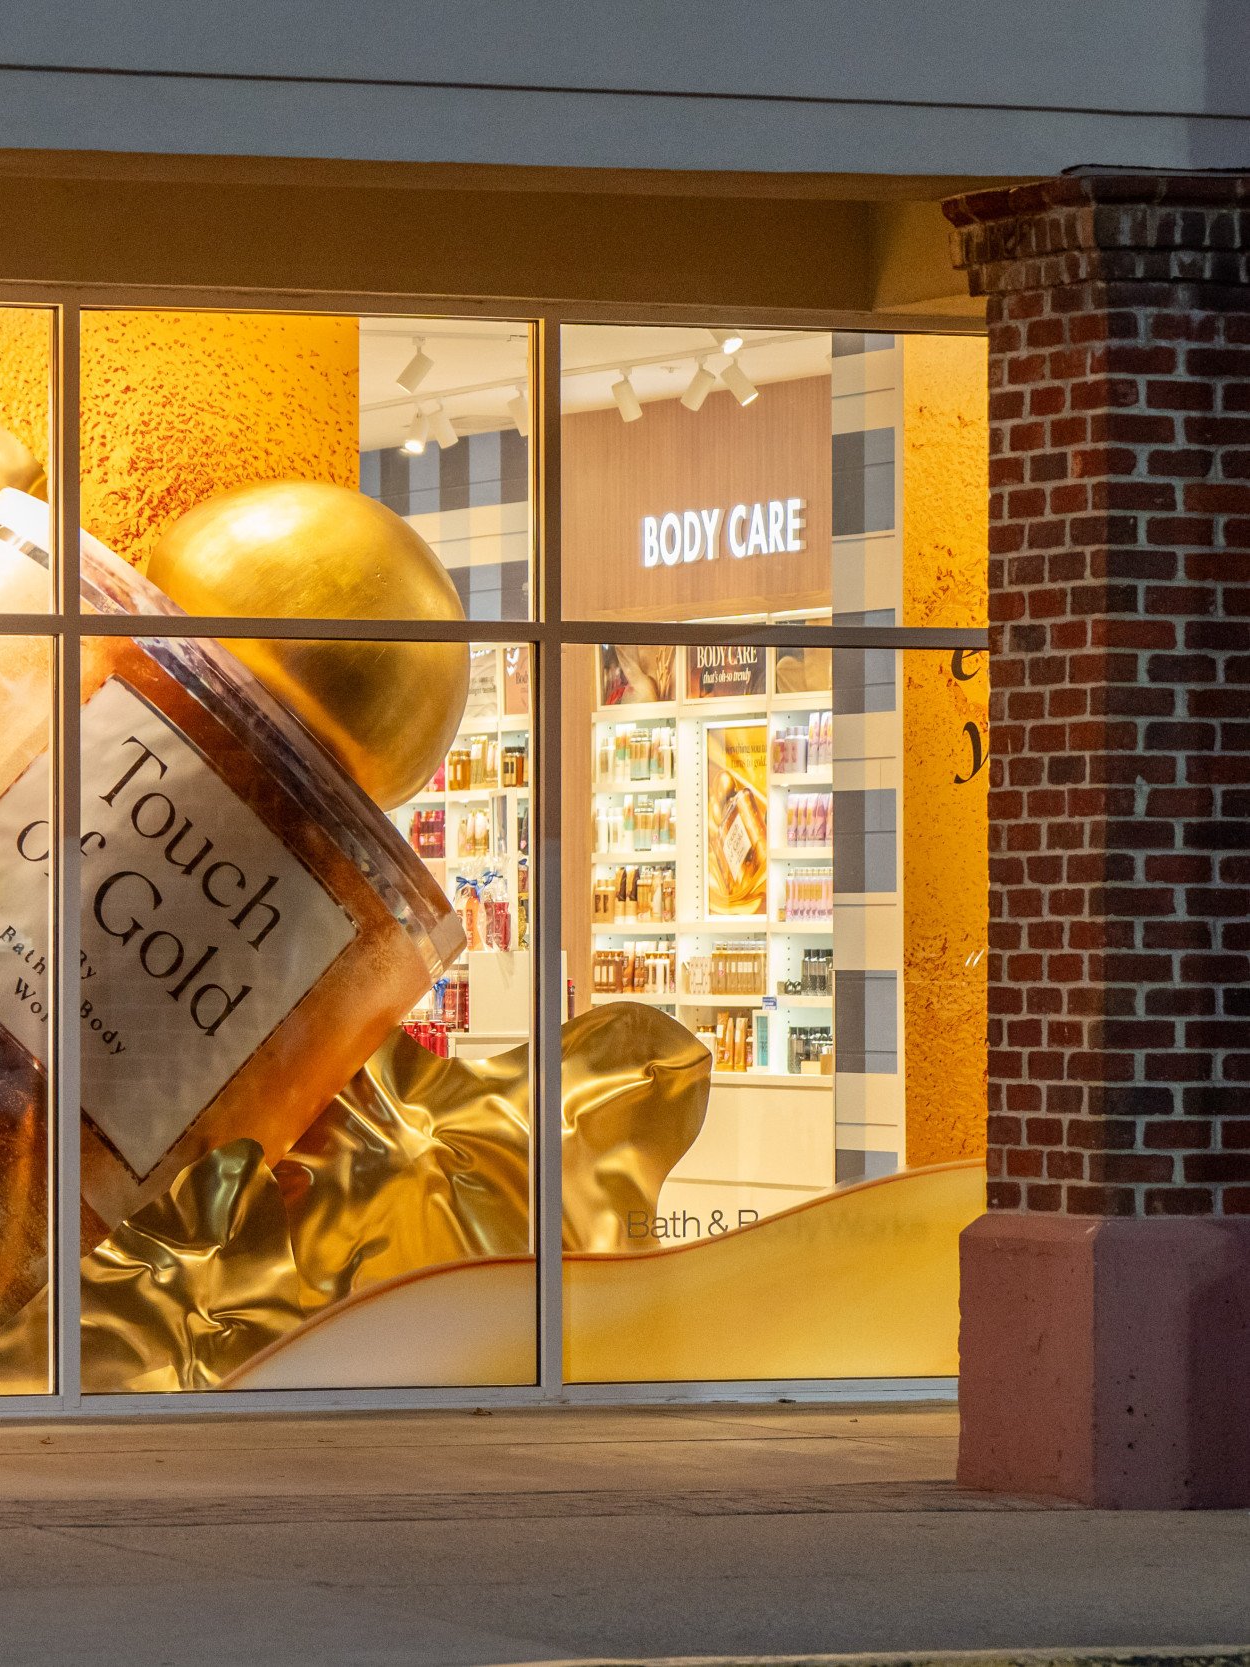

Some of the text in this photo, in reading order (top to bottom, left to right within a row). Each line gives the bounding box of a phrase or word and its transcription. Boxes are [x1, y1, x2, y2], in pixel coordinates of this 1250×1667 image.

[643, 498, 805, 568] BODY CARE
[696, 646, 758, 669] BODY CARE
[98, 735, 280, 951] Touch
[0, 925, 46, 976] Bath
[93, 870, 252, 1037] Gold
[79, 1000, 126, 1055] Body
[626, 1209, 701, 1239] Bath
[707, 1209, 729, 1237] &
